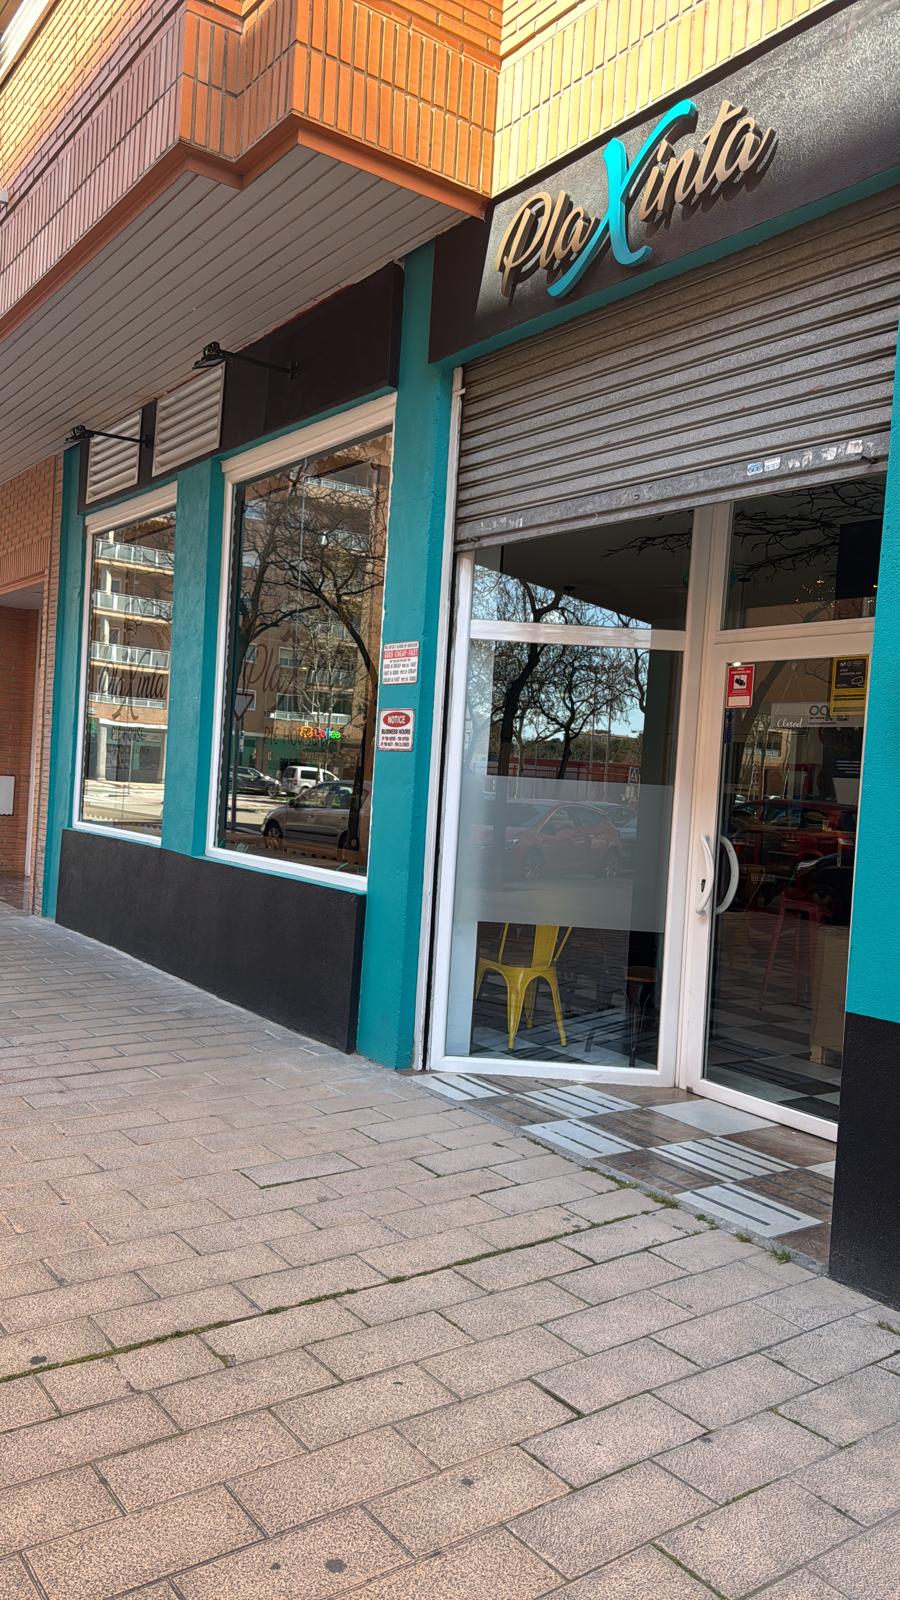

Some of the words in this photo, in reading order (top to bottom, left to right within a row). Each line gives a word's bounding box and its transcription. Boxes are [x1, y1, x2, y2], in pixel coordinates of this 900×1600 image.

[495, 98, 777, 298] PlaXinta
[388, 715, 406, 725] NOTICE
[776, 717, 803, 728] Closed
[313, 727, 341, 740] Coffee
